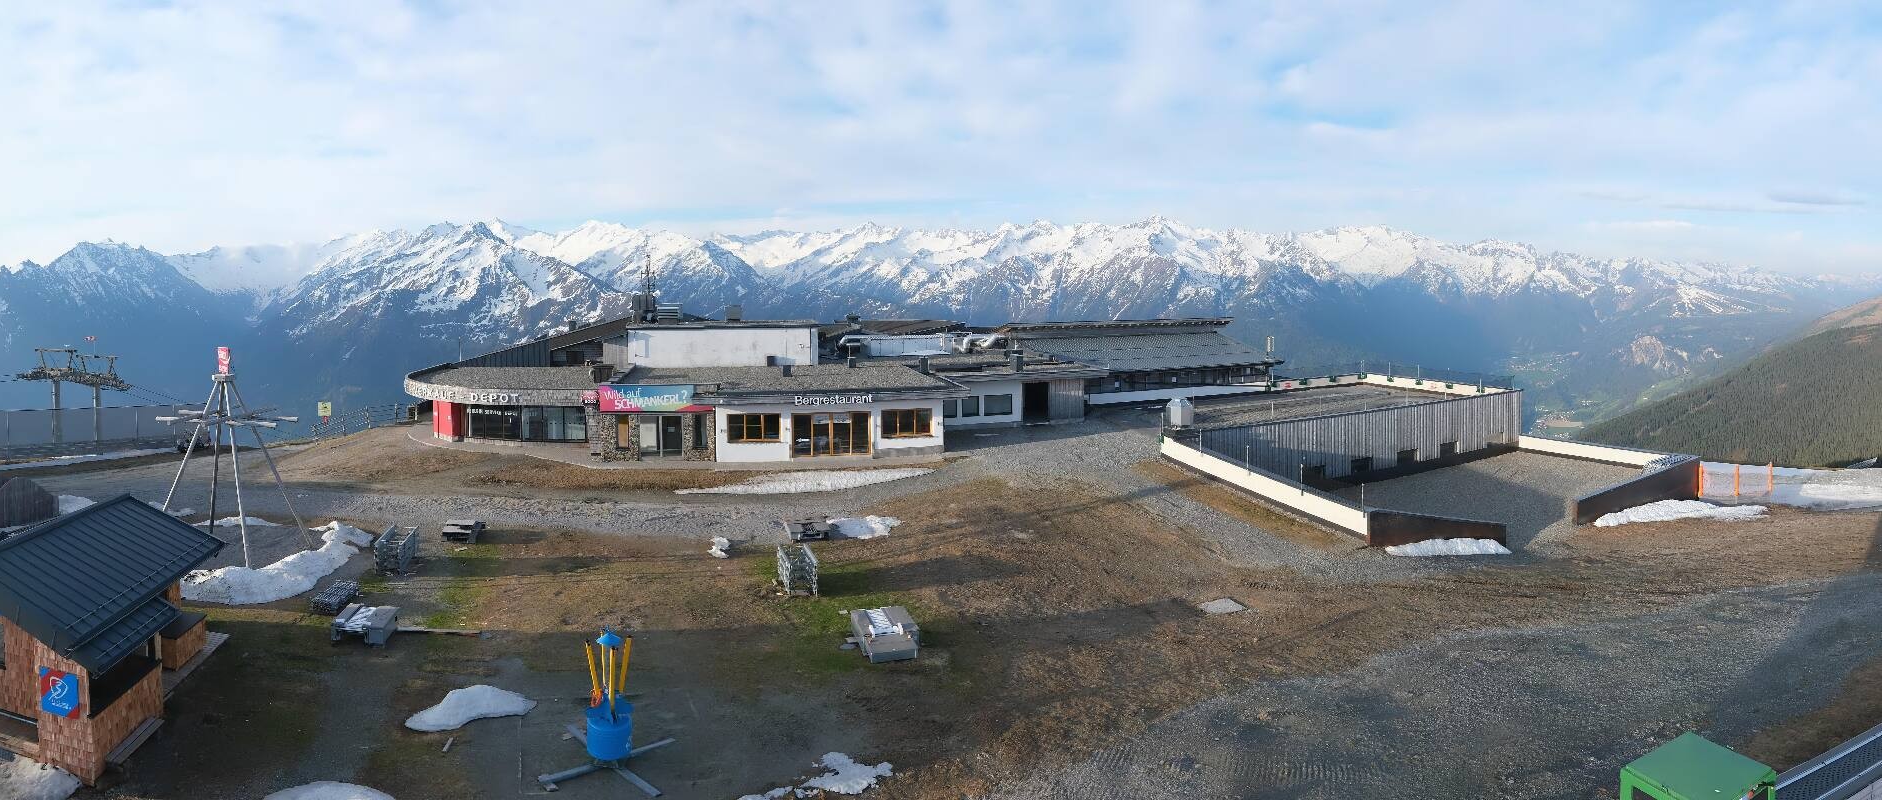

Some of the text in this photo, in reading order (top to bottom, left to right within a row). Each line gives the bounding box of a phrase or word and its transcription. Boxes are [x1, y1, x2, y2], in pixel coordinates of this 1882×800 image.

[470, 392, 519, 402] DEPOT
[604, 389, 624, 400] Wild
[626, 387, 642, 399] auf
[795, 394, 872, 406] Bergrestaurant
